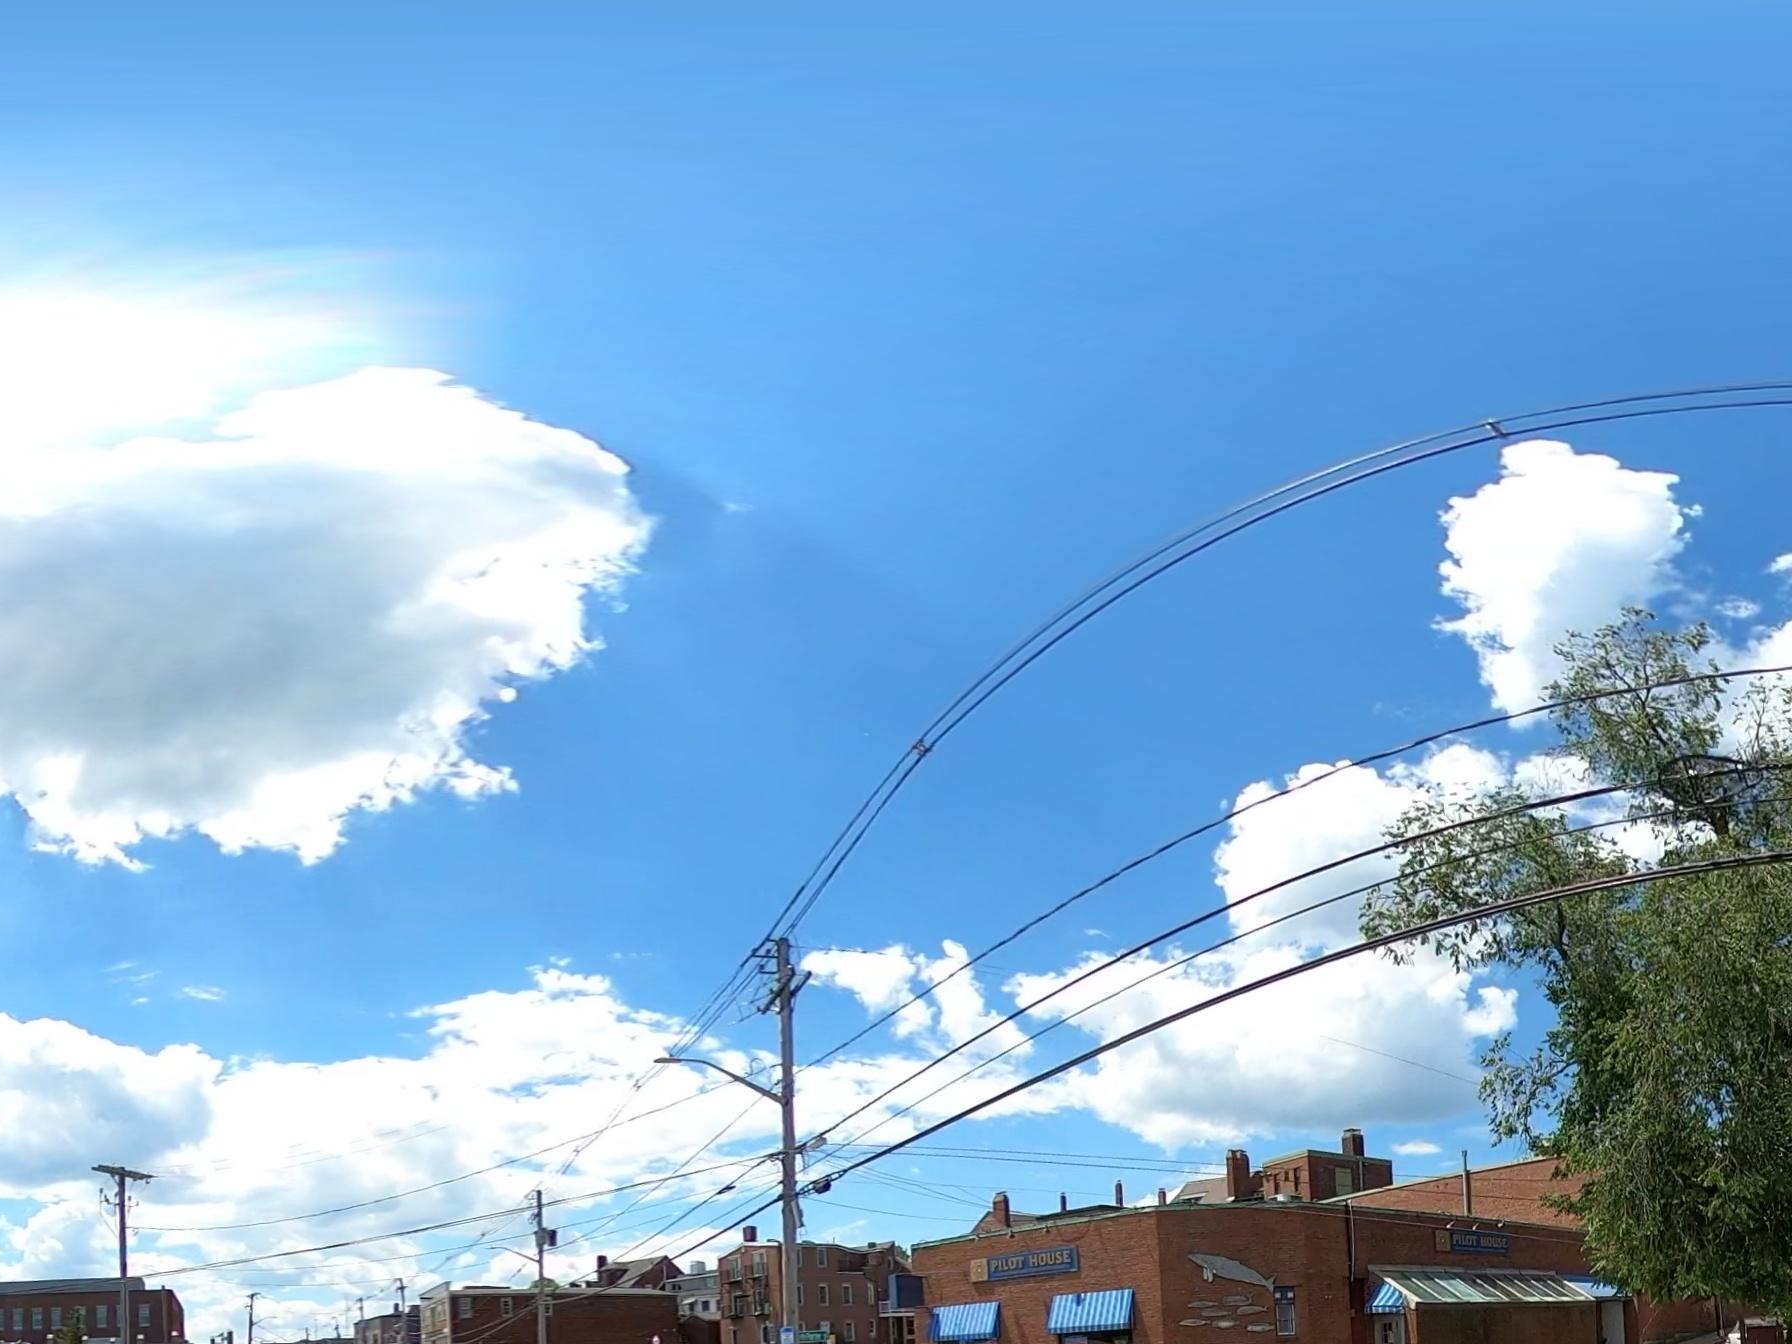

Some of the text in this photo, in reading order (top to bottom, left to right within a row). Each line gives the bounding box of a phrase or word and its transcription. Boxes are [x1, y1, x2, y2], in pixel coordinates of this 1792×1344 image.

[1453, 1234, 1508, 1248] PILOT HOUSE
[991, 1250, 1071, 1271] PILOT HOUSE
